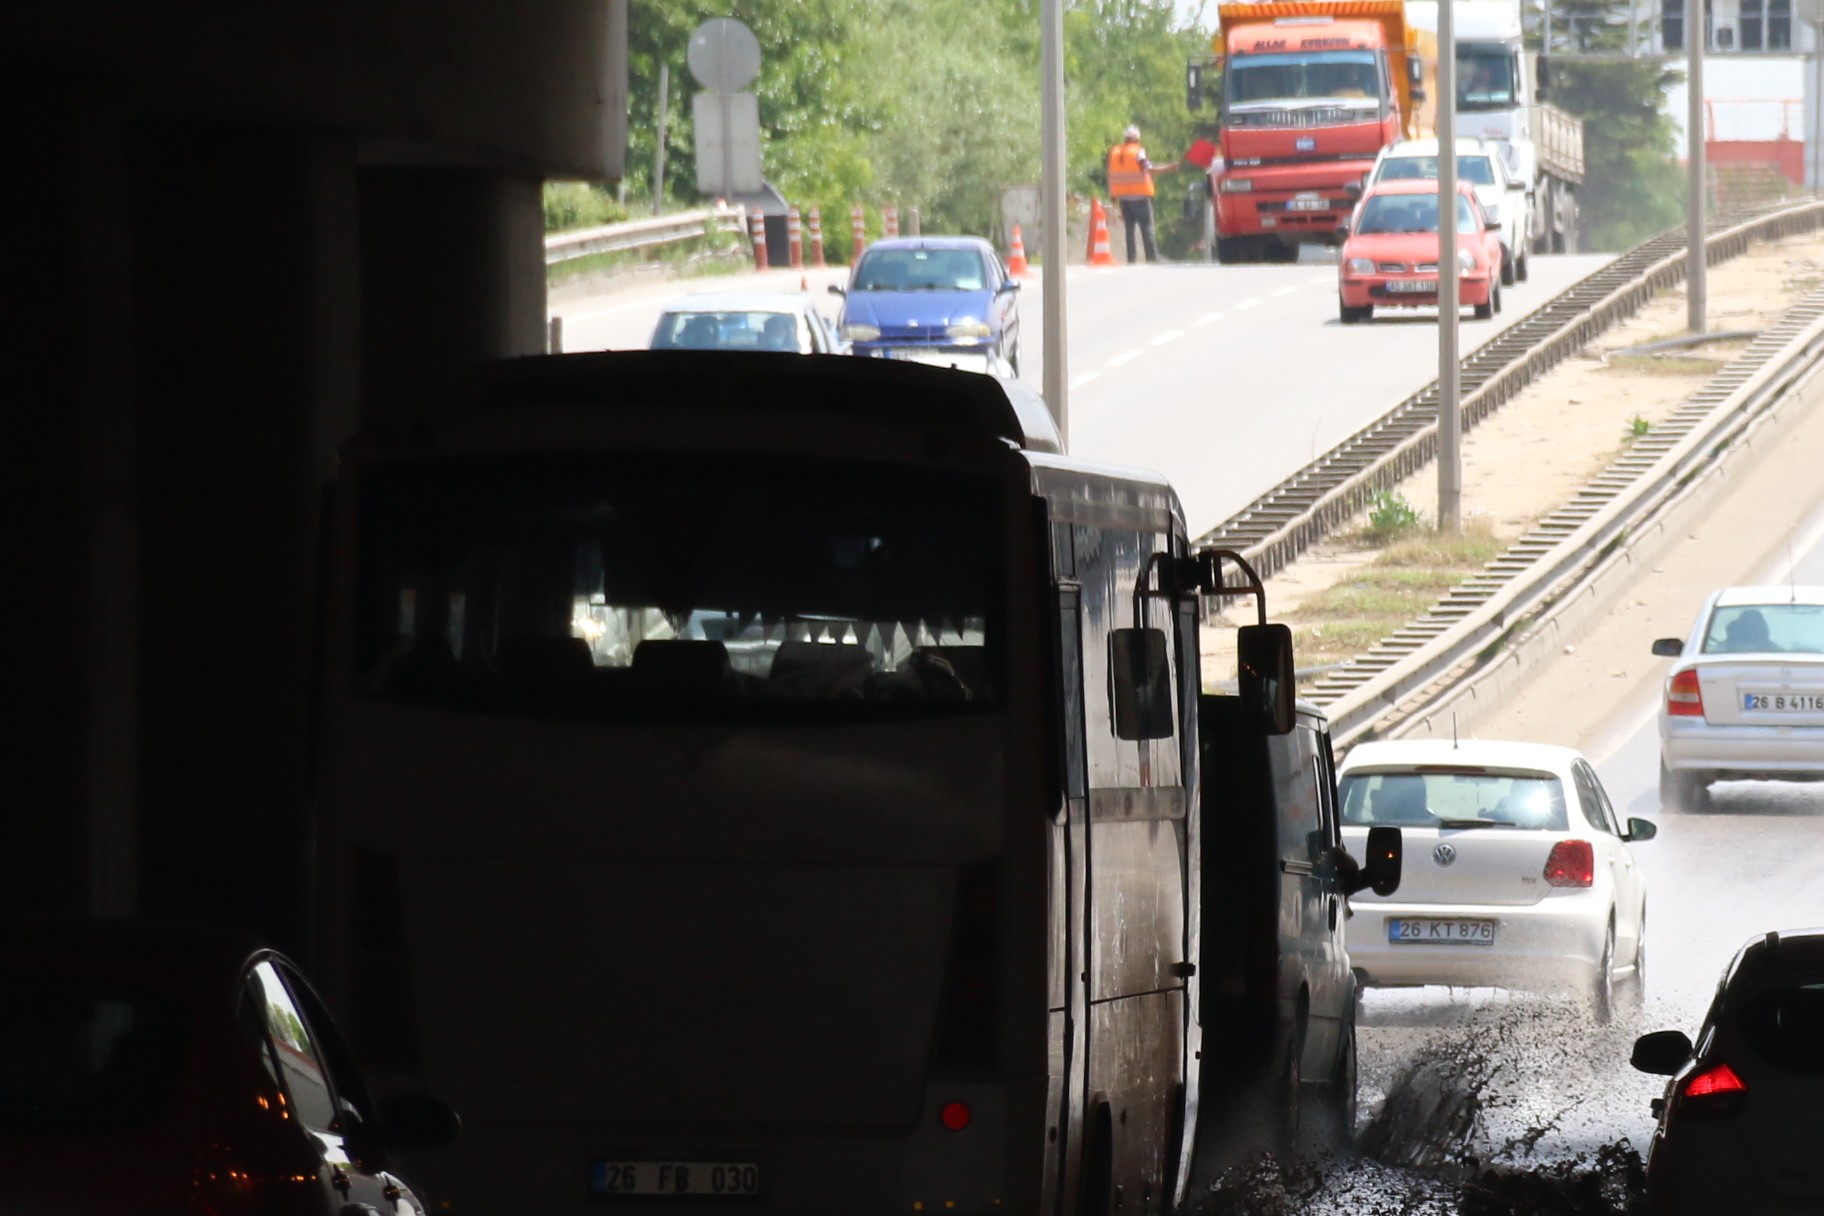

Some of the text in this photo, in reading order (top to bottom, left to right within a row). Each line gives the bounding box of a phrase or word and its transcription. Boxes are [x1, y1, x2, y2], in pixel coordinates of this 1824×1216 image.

[1753, 696, 1824, 709] 26 B 4116
[1401, 922, 1491, 939] 26 KT 876
[607, 1165, 757, 1192] 26 FB 030
